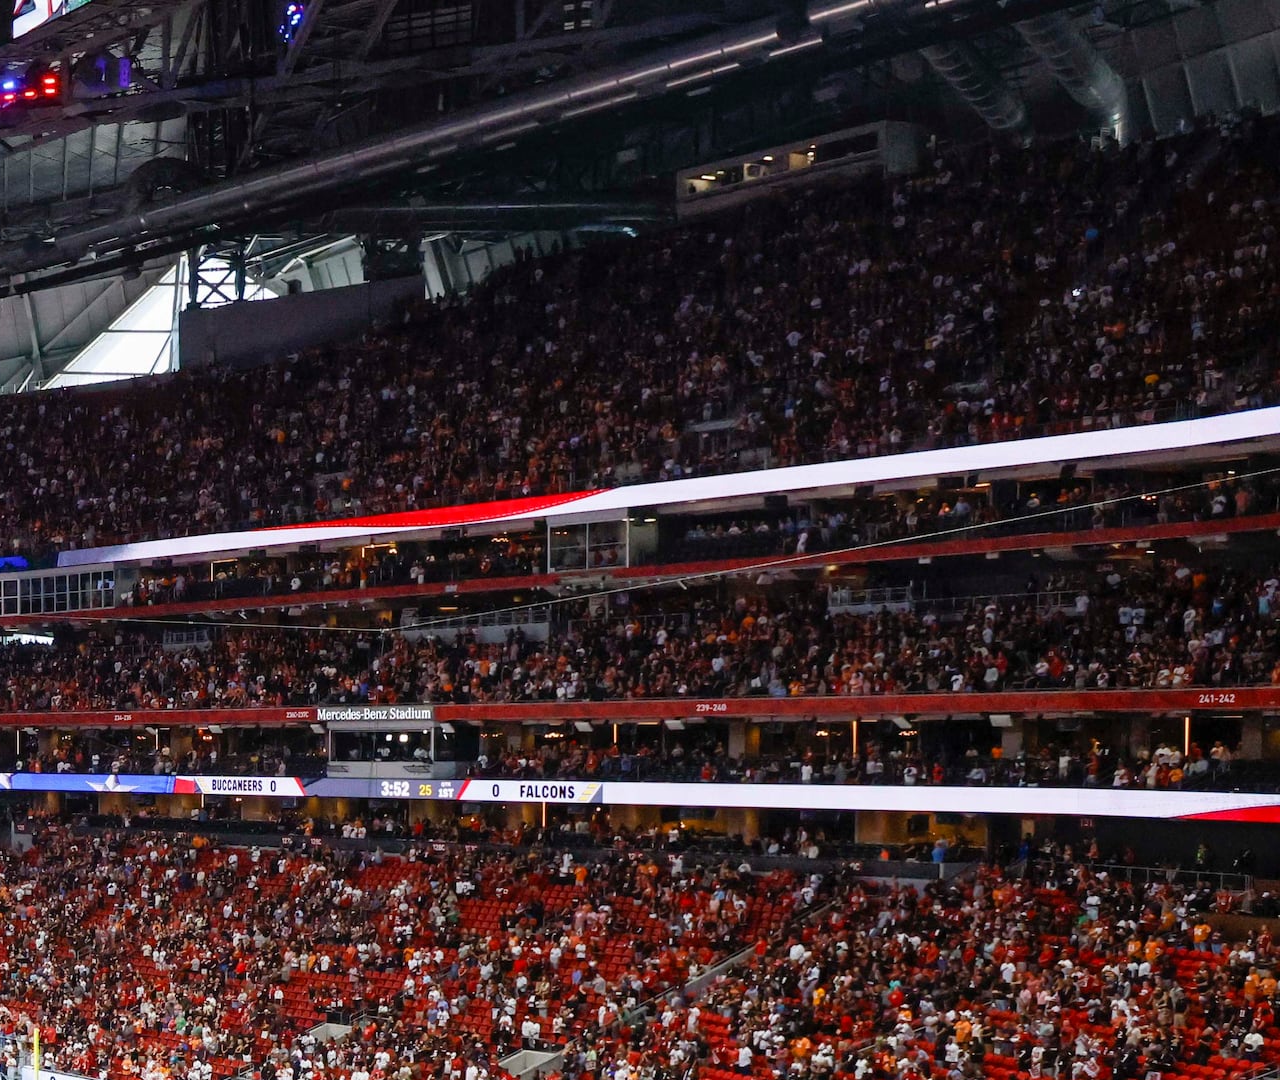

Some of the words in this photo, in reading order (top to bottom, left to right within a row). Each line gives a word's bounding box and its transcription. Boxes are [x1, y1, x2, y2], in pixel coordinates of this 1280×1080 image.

[1199, 694, 1236, 703] 241-242
[317, 708, 388, 720] Mercedes-Benz
[389, 707, 432, 719] Stadium
[696, 703, 727, 712] 239-240
[212, 779, 263, 792] BUCCANEERS
[270, 781, 277, 792] 0
[381, 781, 410, 797] 3:52
[419, 784, 432, 796] 25
[492, 784, 500, 797] 0
[520, 785, 575, 799] FALCONS
[438, 788, 454, 798] 1ST
